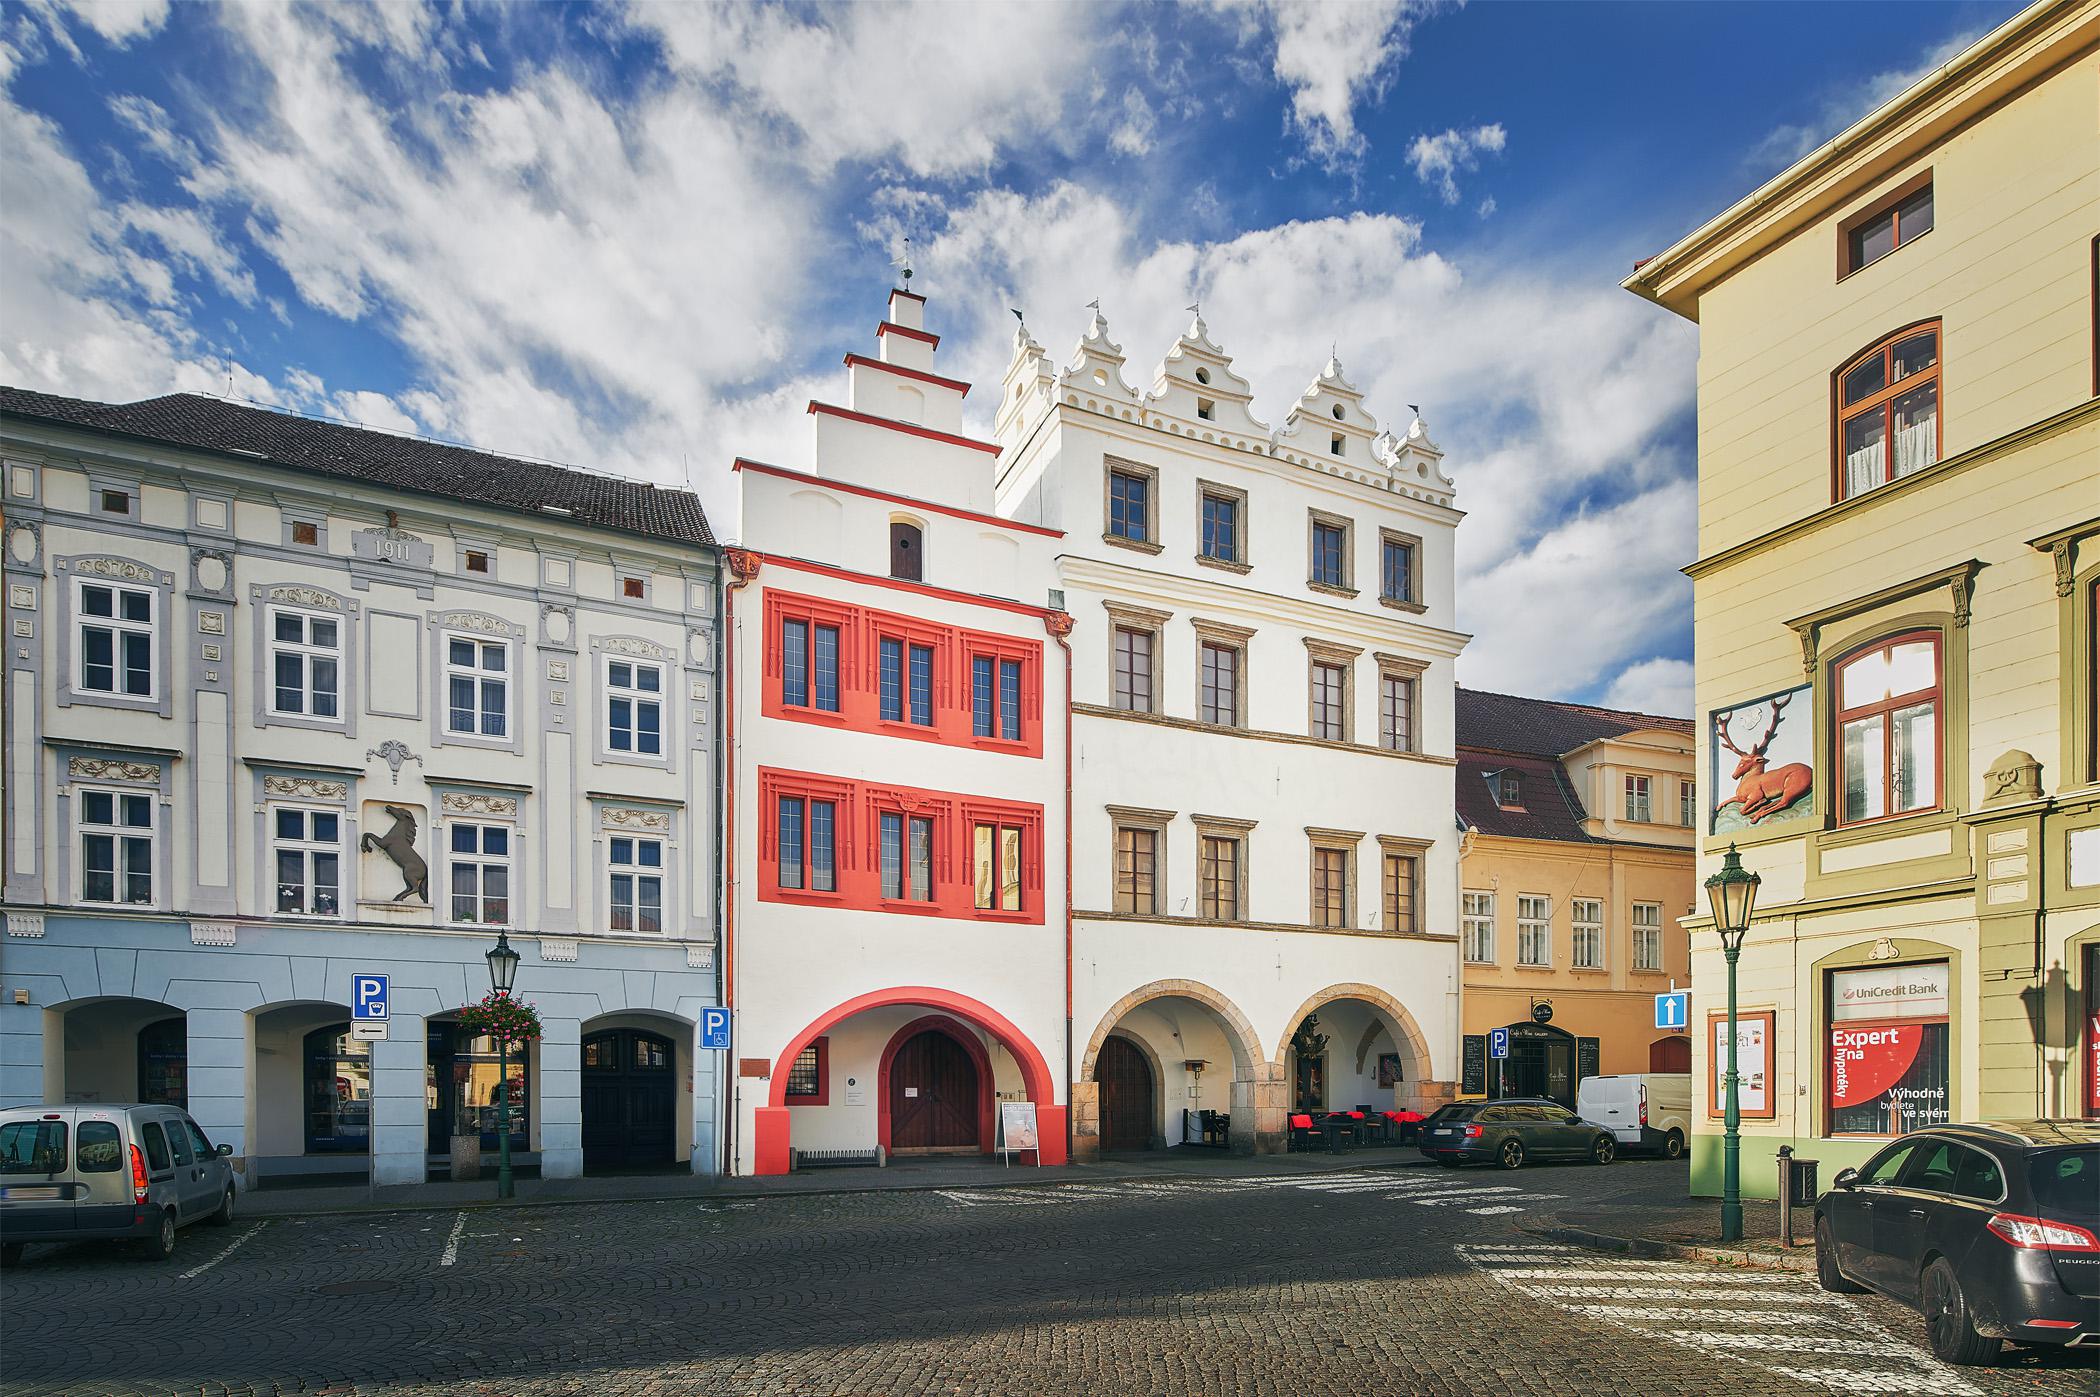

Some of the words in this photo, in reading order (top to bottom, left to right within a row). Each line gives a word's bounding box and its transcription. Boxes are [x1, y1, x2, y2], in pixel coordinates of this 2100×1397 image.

[375, 540, 409, 561] 1911
[360, 979, 382, 1006] P
[1856, 985, 1906, 999] UniCredit
[1909, 983, 1938, 995] Bank
[707, 1012, 724, 1036] P
[1494, 1032, 1504, 1049] P
[1832, 1028, 1899, 1049] Expert
[1846, 1050, 1864, 1060] na
[1834, 1048, 1849, 1098] hypotéky
[1888, 1087, 1945, 1101] Výhodně
[1880, 1101, 1915, 1111] bydlete
[1902, 1110, 1916, 1118] ve
